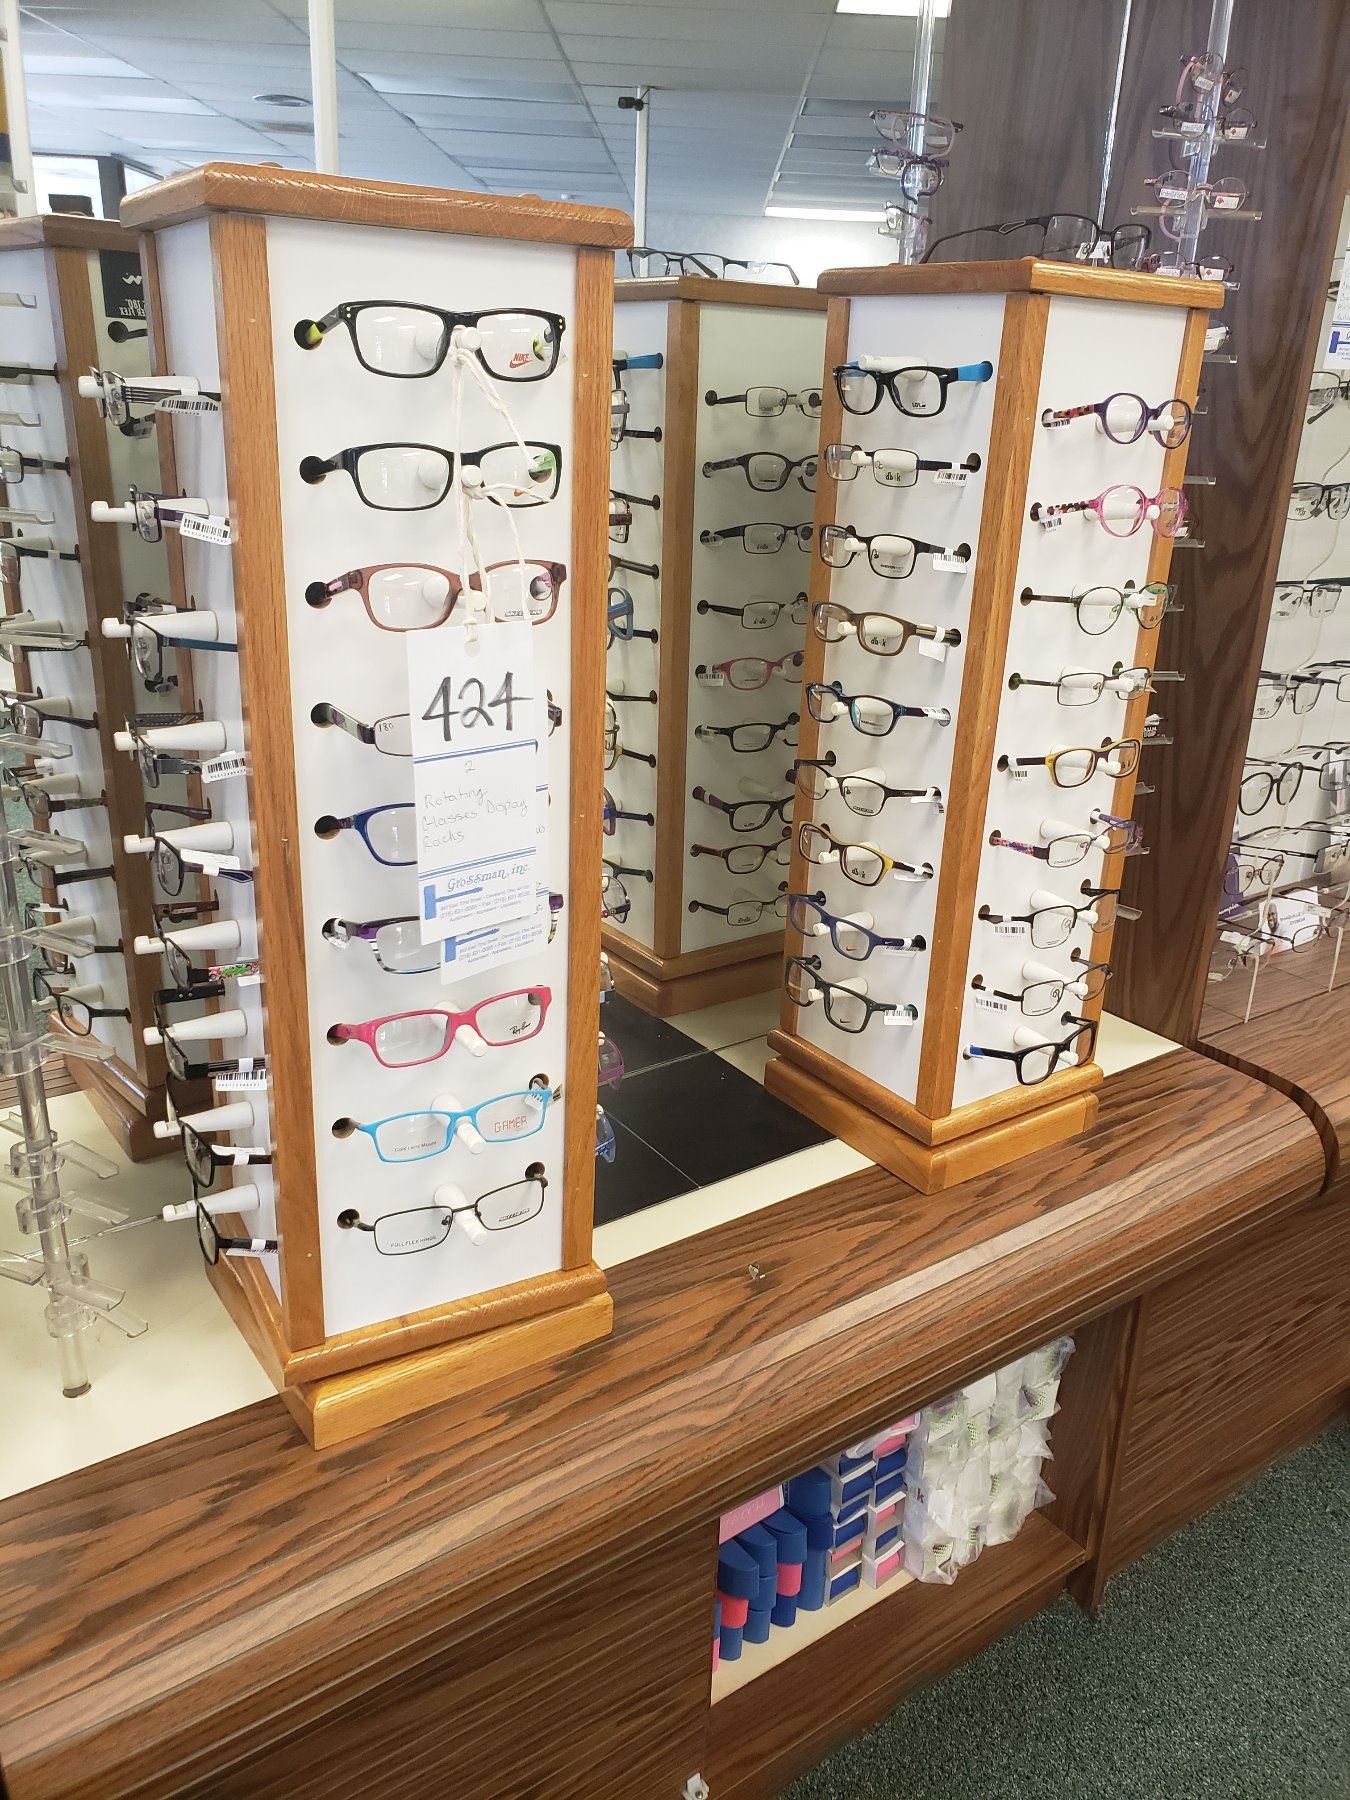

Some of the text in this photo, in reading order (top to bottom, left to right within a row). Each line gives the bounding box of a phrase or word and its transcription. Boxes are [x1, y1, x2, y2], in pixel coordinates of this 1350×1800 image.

[513, 352, 530, 362] NIKE
[421, 670, 535, 742] 424
[464, 760, 476, 774] 2
[424, 787, 489, 809] Rotating
[493, 1115, 528, 1134] GAMER
